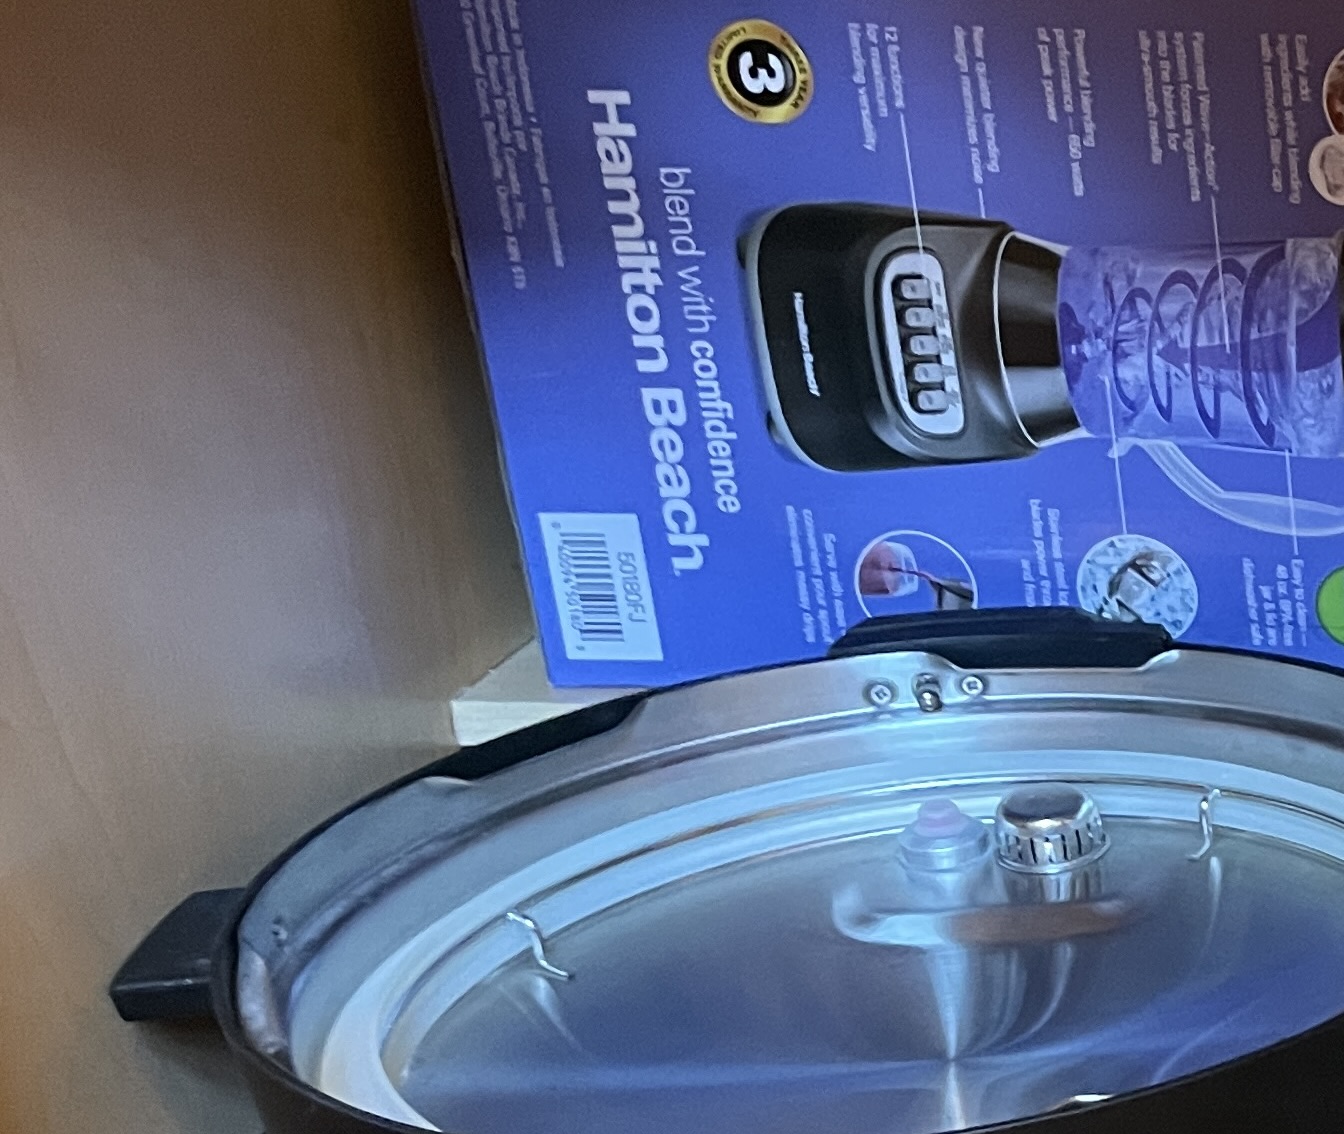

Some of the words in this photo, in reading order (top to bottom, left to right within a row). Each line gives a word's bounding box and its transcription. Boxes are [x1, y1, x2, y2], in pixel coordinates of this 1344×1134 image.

[865, 23, 879, 44] for
[884, 27, 898, 42] 12
[738, 51, 786, 94] 3
[887, 44, 905, 109] functions
[1299, 75, 1312, 102] add
[1041, 79, 1058, 123] power
[1079, 90, 1096, 147] blending
[1180, 83, 1192, 126] forces
[970, 147, 983, 184] noise
[983, 113, 1000, 172] blending
[1168, 132, 1180, 152] for
[1183, 129, 1201, 202] ingredients
[1288, 148, 1302, 204] blending
[586, 90, 668, 372] Hamilton
[658, 167, 705, 255] blend
[676, 265, 716, 333] with
[689, 341, 741, 513] confidence
[617, 552, 647, 623] 50180FJ
